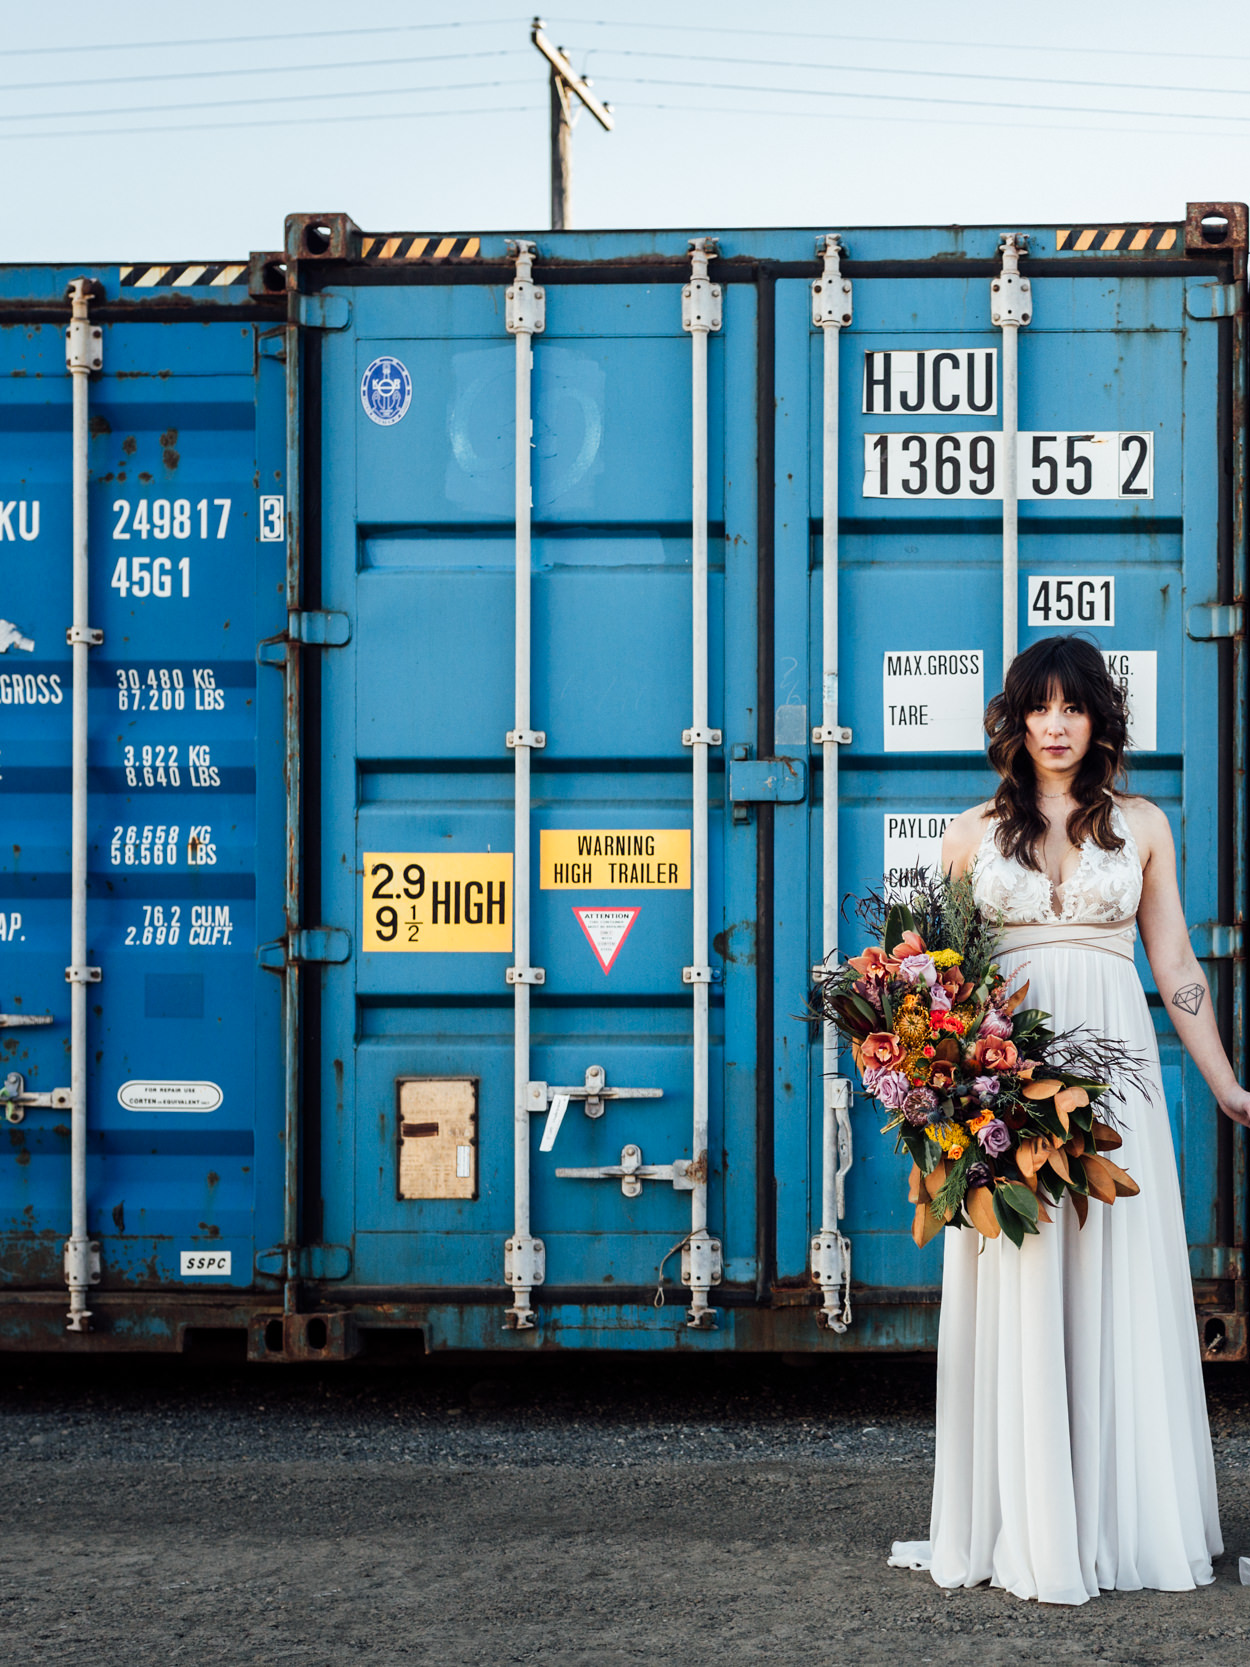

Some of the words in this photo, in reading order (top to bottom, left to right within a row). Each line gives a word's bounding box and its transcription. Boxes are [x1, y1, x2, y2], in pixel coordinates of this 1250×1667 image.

[866, 352, 994, 413] HJCU
[873, 435, 995, 495] 1369
[1032, 435, 1092, 495] 55
[1121, 435, 1149, 495] 2
[112, 499, 231, 540] 249817
[263, 499, 280, 539] 3
[111, 557, 190, 598] 45G1
[1032, 580, 1111, 622] 45G1
[887, 654, 980, 677] MAX.GROSS
[1108, 655, 1134, 676] KG.
[192, 668, 216, 690] KG
[195, 689, 225, 711] LBS
[888, 705, 929, 726] TARE
[124, 745, 179, 767] 3,922
[188, 745, 211, 767] KG
[189, 766, 221, 787] LBS
[111, 825, 180, 845] 26,558
[189, 825, 212, 845] KG
[888, 818, 955, 839] PAYLOA
[110, 844, 178, 866] 58,560
[186, 844, 217, 866] LBS
[577, 835, 656, 856] WARNING
[553, 863, 593, 884] HIGH
[608, 863, 679, 884] TRAILER
[371, 863, 425, 899] 2.9
[432, 881, 506, 924] HIGH
[142, 905, 181, 927] 76.2
[190, 905, 233, 927] CU.M.
[375, 905, 398, 942] 9
[188, 926, 233, 946] CU.FT.
[186, 1258, 226, 1269] SSPC
